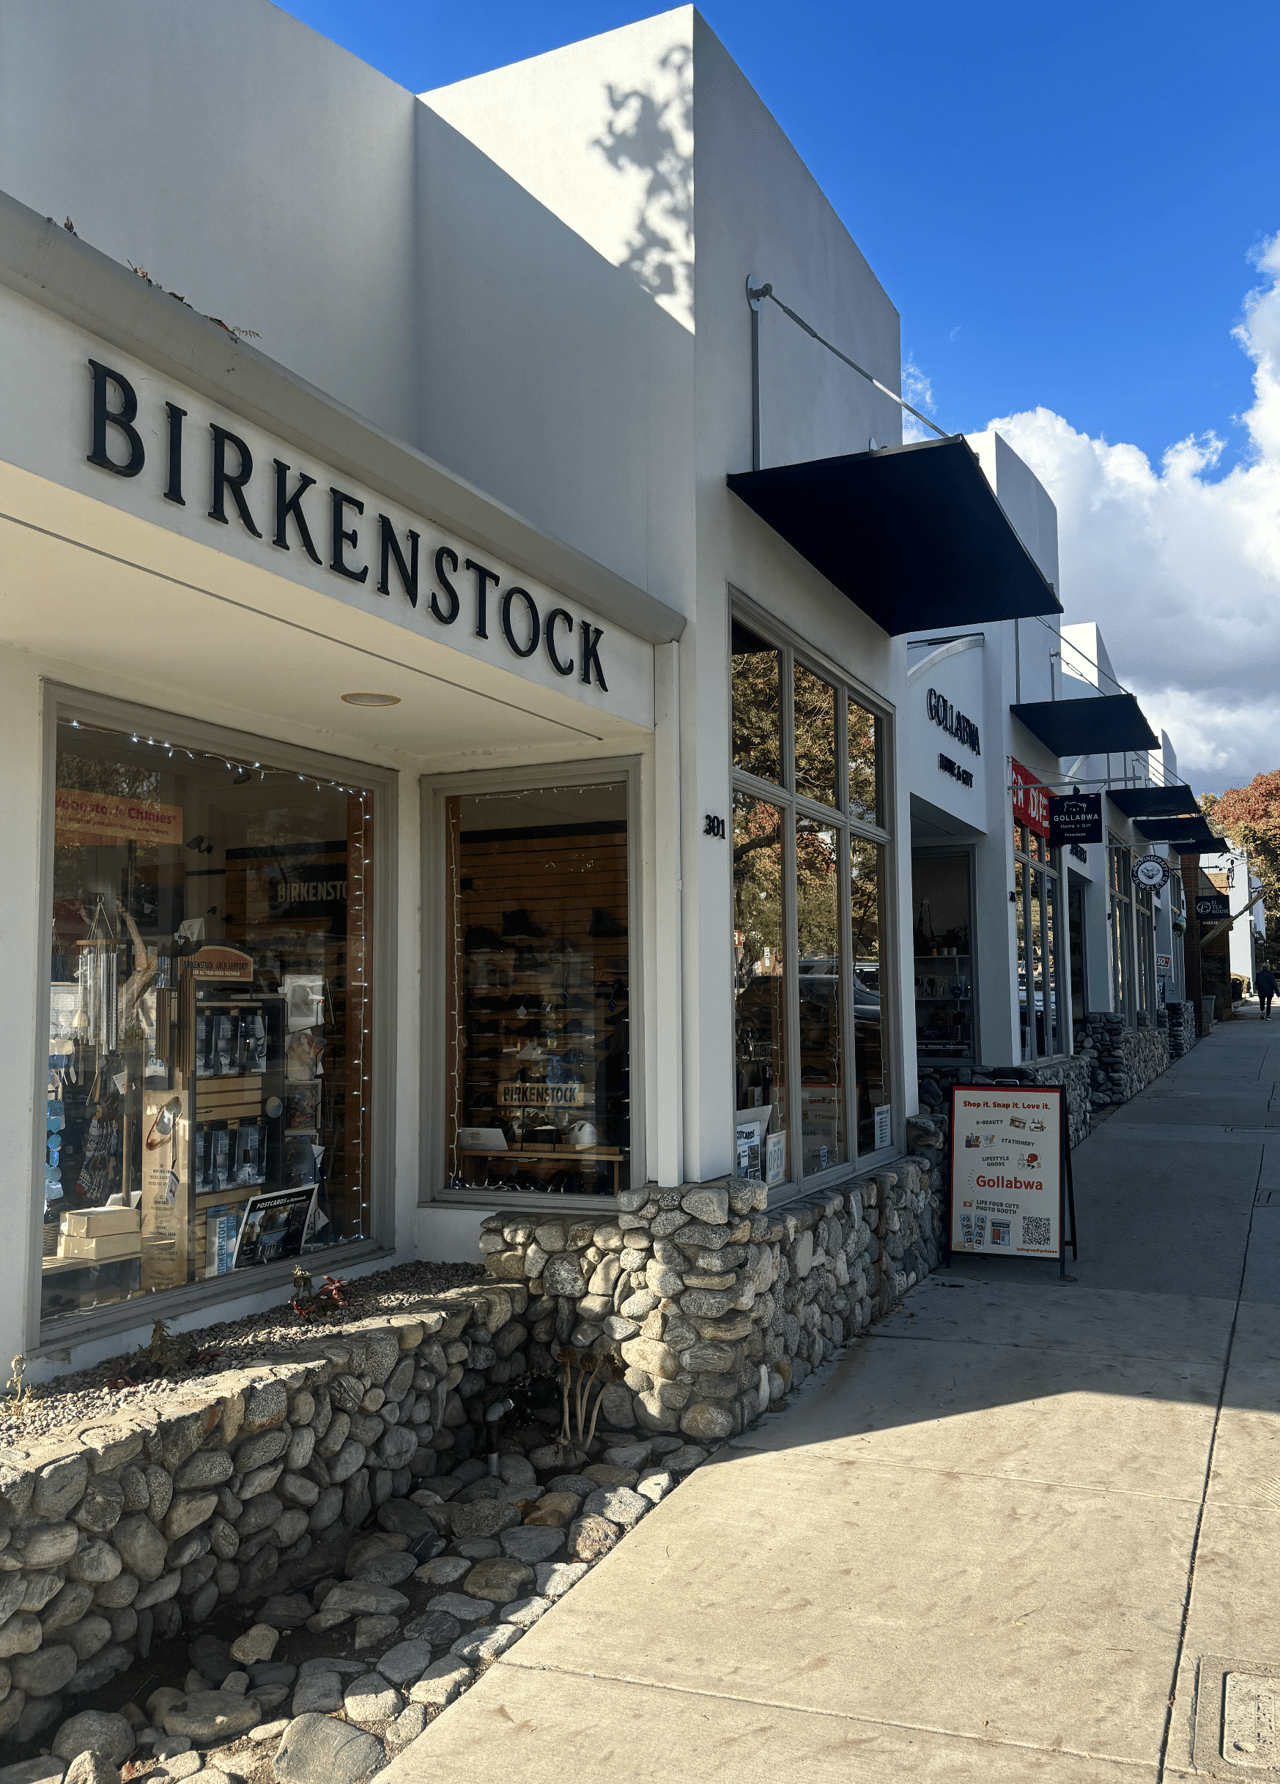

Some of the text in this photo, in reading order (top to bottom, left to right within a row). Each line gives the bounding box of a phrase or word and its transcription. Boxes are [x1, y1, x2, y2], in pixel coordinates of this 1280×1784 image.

[86, 360, 608, 692] BIRKENSTOCK
[926, 687, 981, 756] GOLLABWA
[1053, 813, 1099, 822] GOLLABWA
[704, 814, 726, 839] 301
[1132, 876, 1168, 891] JEWELERS
[503, 1086, 577, 1103] BIRKENSTOCK
[963, 1100, 981, 1109] Shop
[992, 1101, 1010, 1110] Snap
[1022, 1102, 1040, 1110] Love
[1001, 1138, 1035, 1147] STATIONERY
[976, 1175, 1043, 1191] Gollabwa
[255, 1197, 287, 1210] POSTCARDS
[975, 1205, 1017, 1215] PHOTO BOOTH
[988, 1200, 1003, 1208] FOUR
[1004, 1202, 1020, 1210] CUTS
